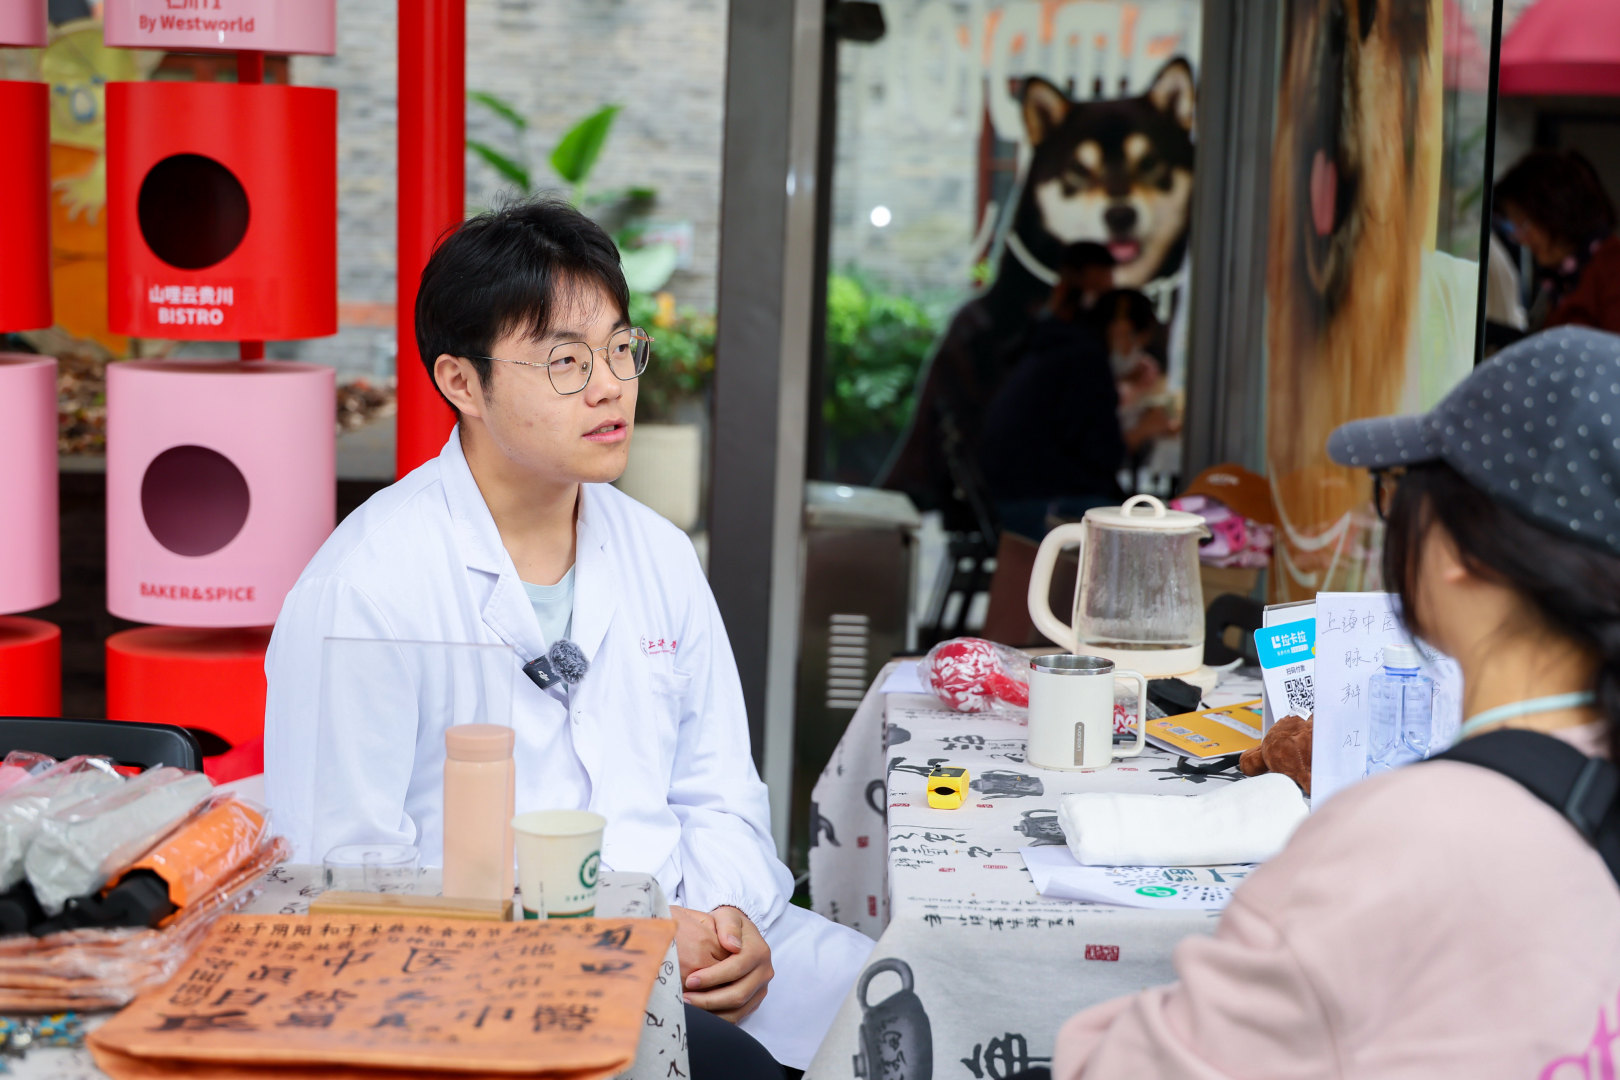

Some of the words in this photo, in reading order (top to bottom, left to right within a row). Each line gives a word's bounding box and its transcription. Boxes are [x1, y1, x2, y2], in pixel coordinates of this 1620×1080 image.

[139, 15, 156, 33] By
[160, 15, 255, 33] Westworld
[158, 307, 224, 325] BISTRO
[1281, 630, 1307, 647] 拉卡拉
